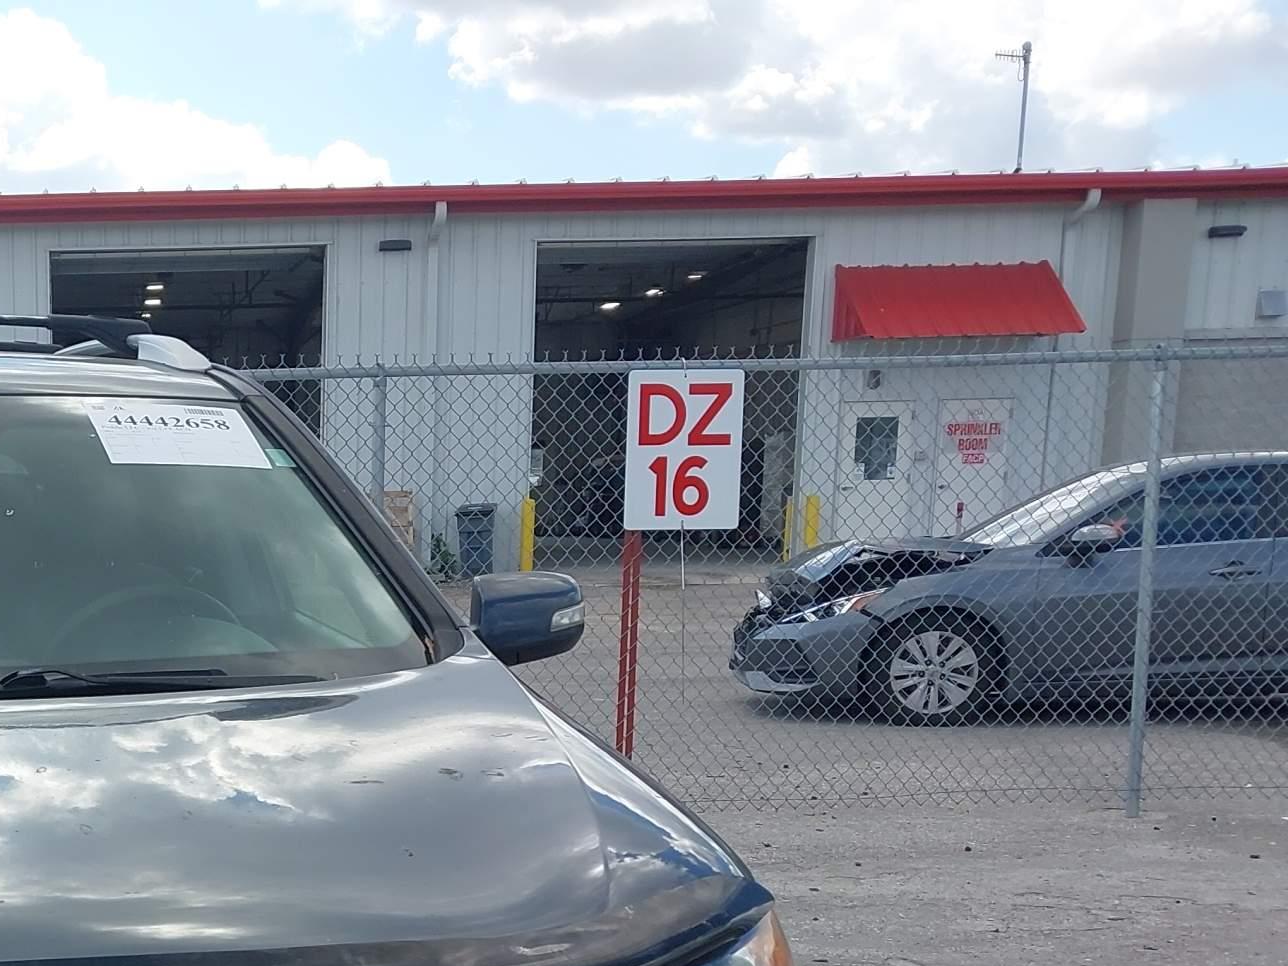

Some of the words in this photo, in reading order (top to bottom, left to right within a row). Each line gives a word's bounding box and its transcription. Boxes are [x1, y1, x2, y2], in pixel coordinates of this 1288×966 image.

[107, 415, 231, 431] 44442658
[638, 384, 733, 446] DZ
[946, 422, 1001, 436] SPRINKLER
[648, 456, 710, 517] 16
